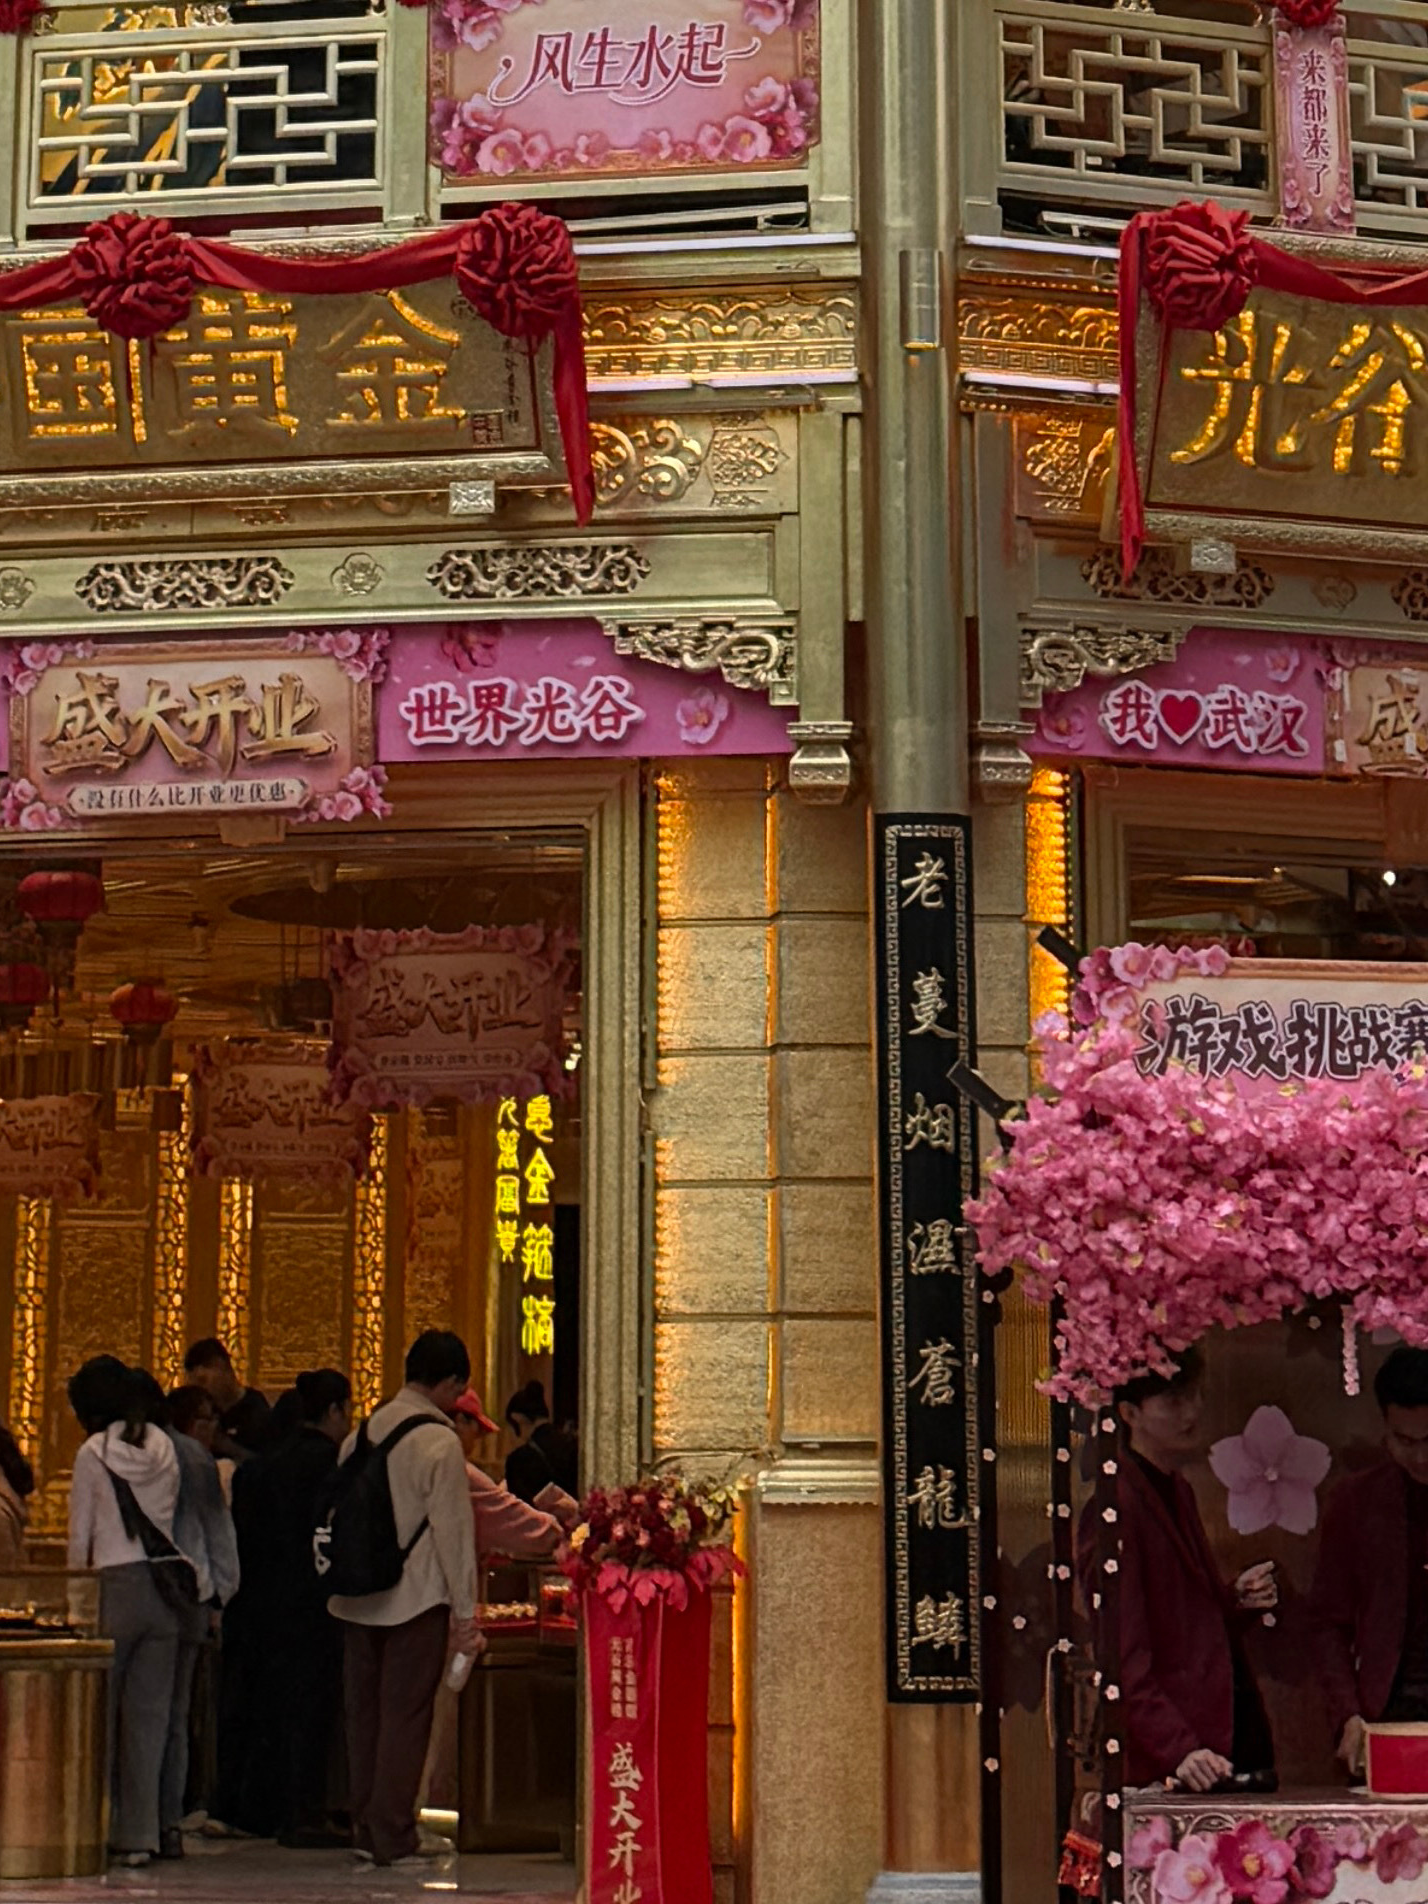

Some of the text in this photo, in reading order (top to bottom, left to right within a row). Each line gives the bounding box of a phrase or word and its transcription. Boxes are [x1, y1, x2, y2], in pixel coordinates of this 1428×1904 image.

[487, 20, 762, 107] 风生水起
[1298, 48, 1332, 198] 来都来了
[42, 671, 338, 782] 盛大开业
[406, 678, 640, 748] 世界光谷
[1105, 684, 1307, 754] 我 武汉
[355, 966, 542, 1042] 盛大开业
